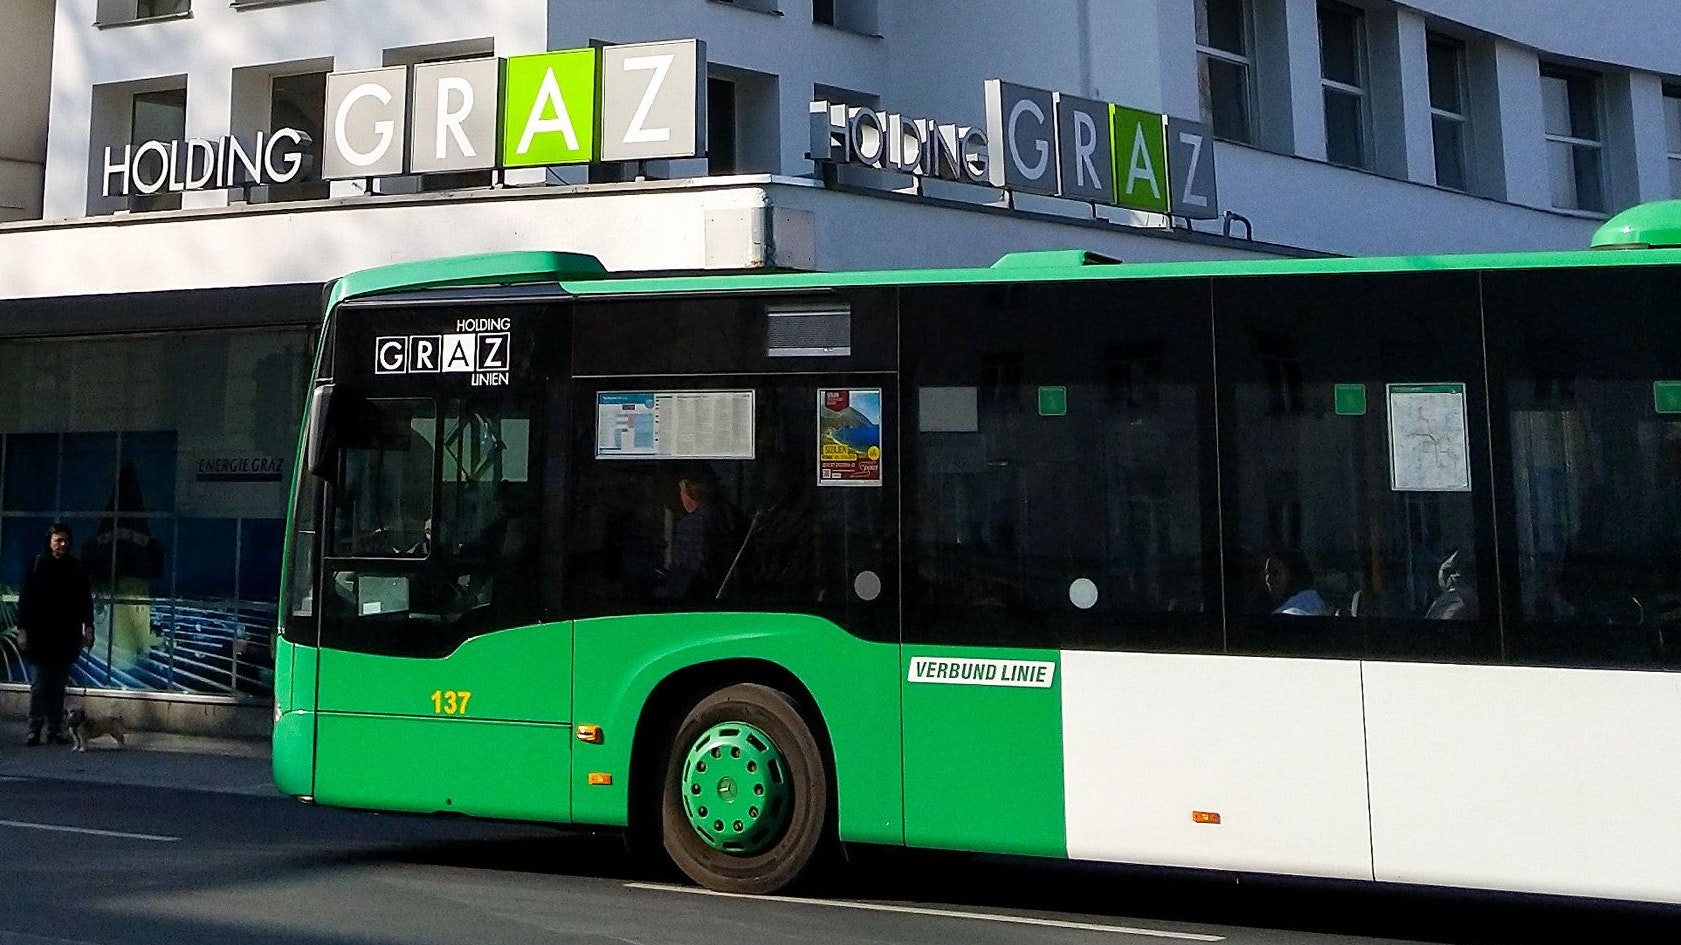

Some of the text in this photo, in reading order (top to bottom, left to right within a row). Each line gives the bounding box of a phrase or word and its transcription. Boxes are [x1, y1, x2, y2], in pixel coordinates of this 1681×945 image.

[102, 54, 677, 197] HOLDING GRAZ
[813, 98, 1208, 208] HOLDING GRAZ
[456, 318, 511, 332] HOLDING
[379, 337, 503, 370] GRAZ
[471, 372, 509, 386] LINIEN
[198, 458, 284, 472] ENERGIE GRAZ
[916, 661, 1047, 683] VERBUND LINIE
[430, 690, 472, 715] 137
